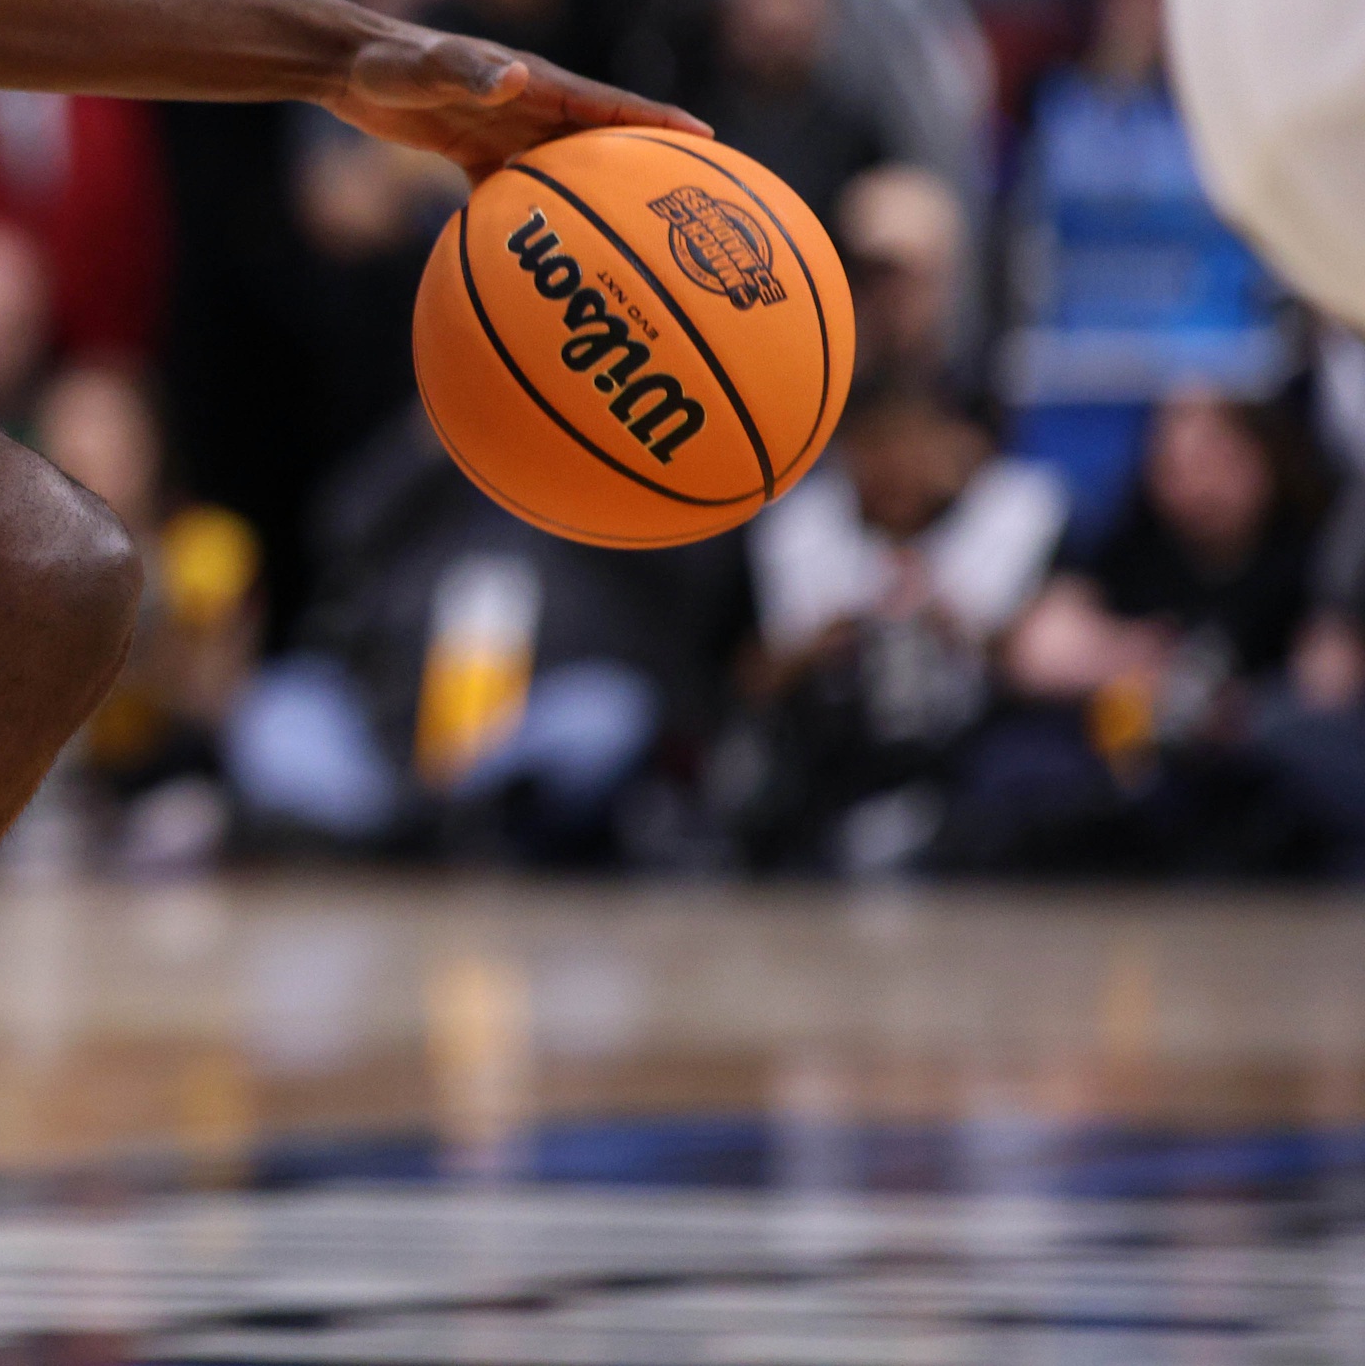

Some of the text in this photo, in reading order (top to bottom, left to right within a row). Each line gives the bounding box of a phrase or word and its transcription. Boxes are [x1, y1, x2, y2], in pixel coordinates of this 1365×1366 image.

[681, 220, 743, 290] MARCH
[506, 205, 707, 466] Wilson
[597, 270, 660, 341] EVO NXT
